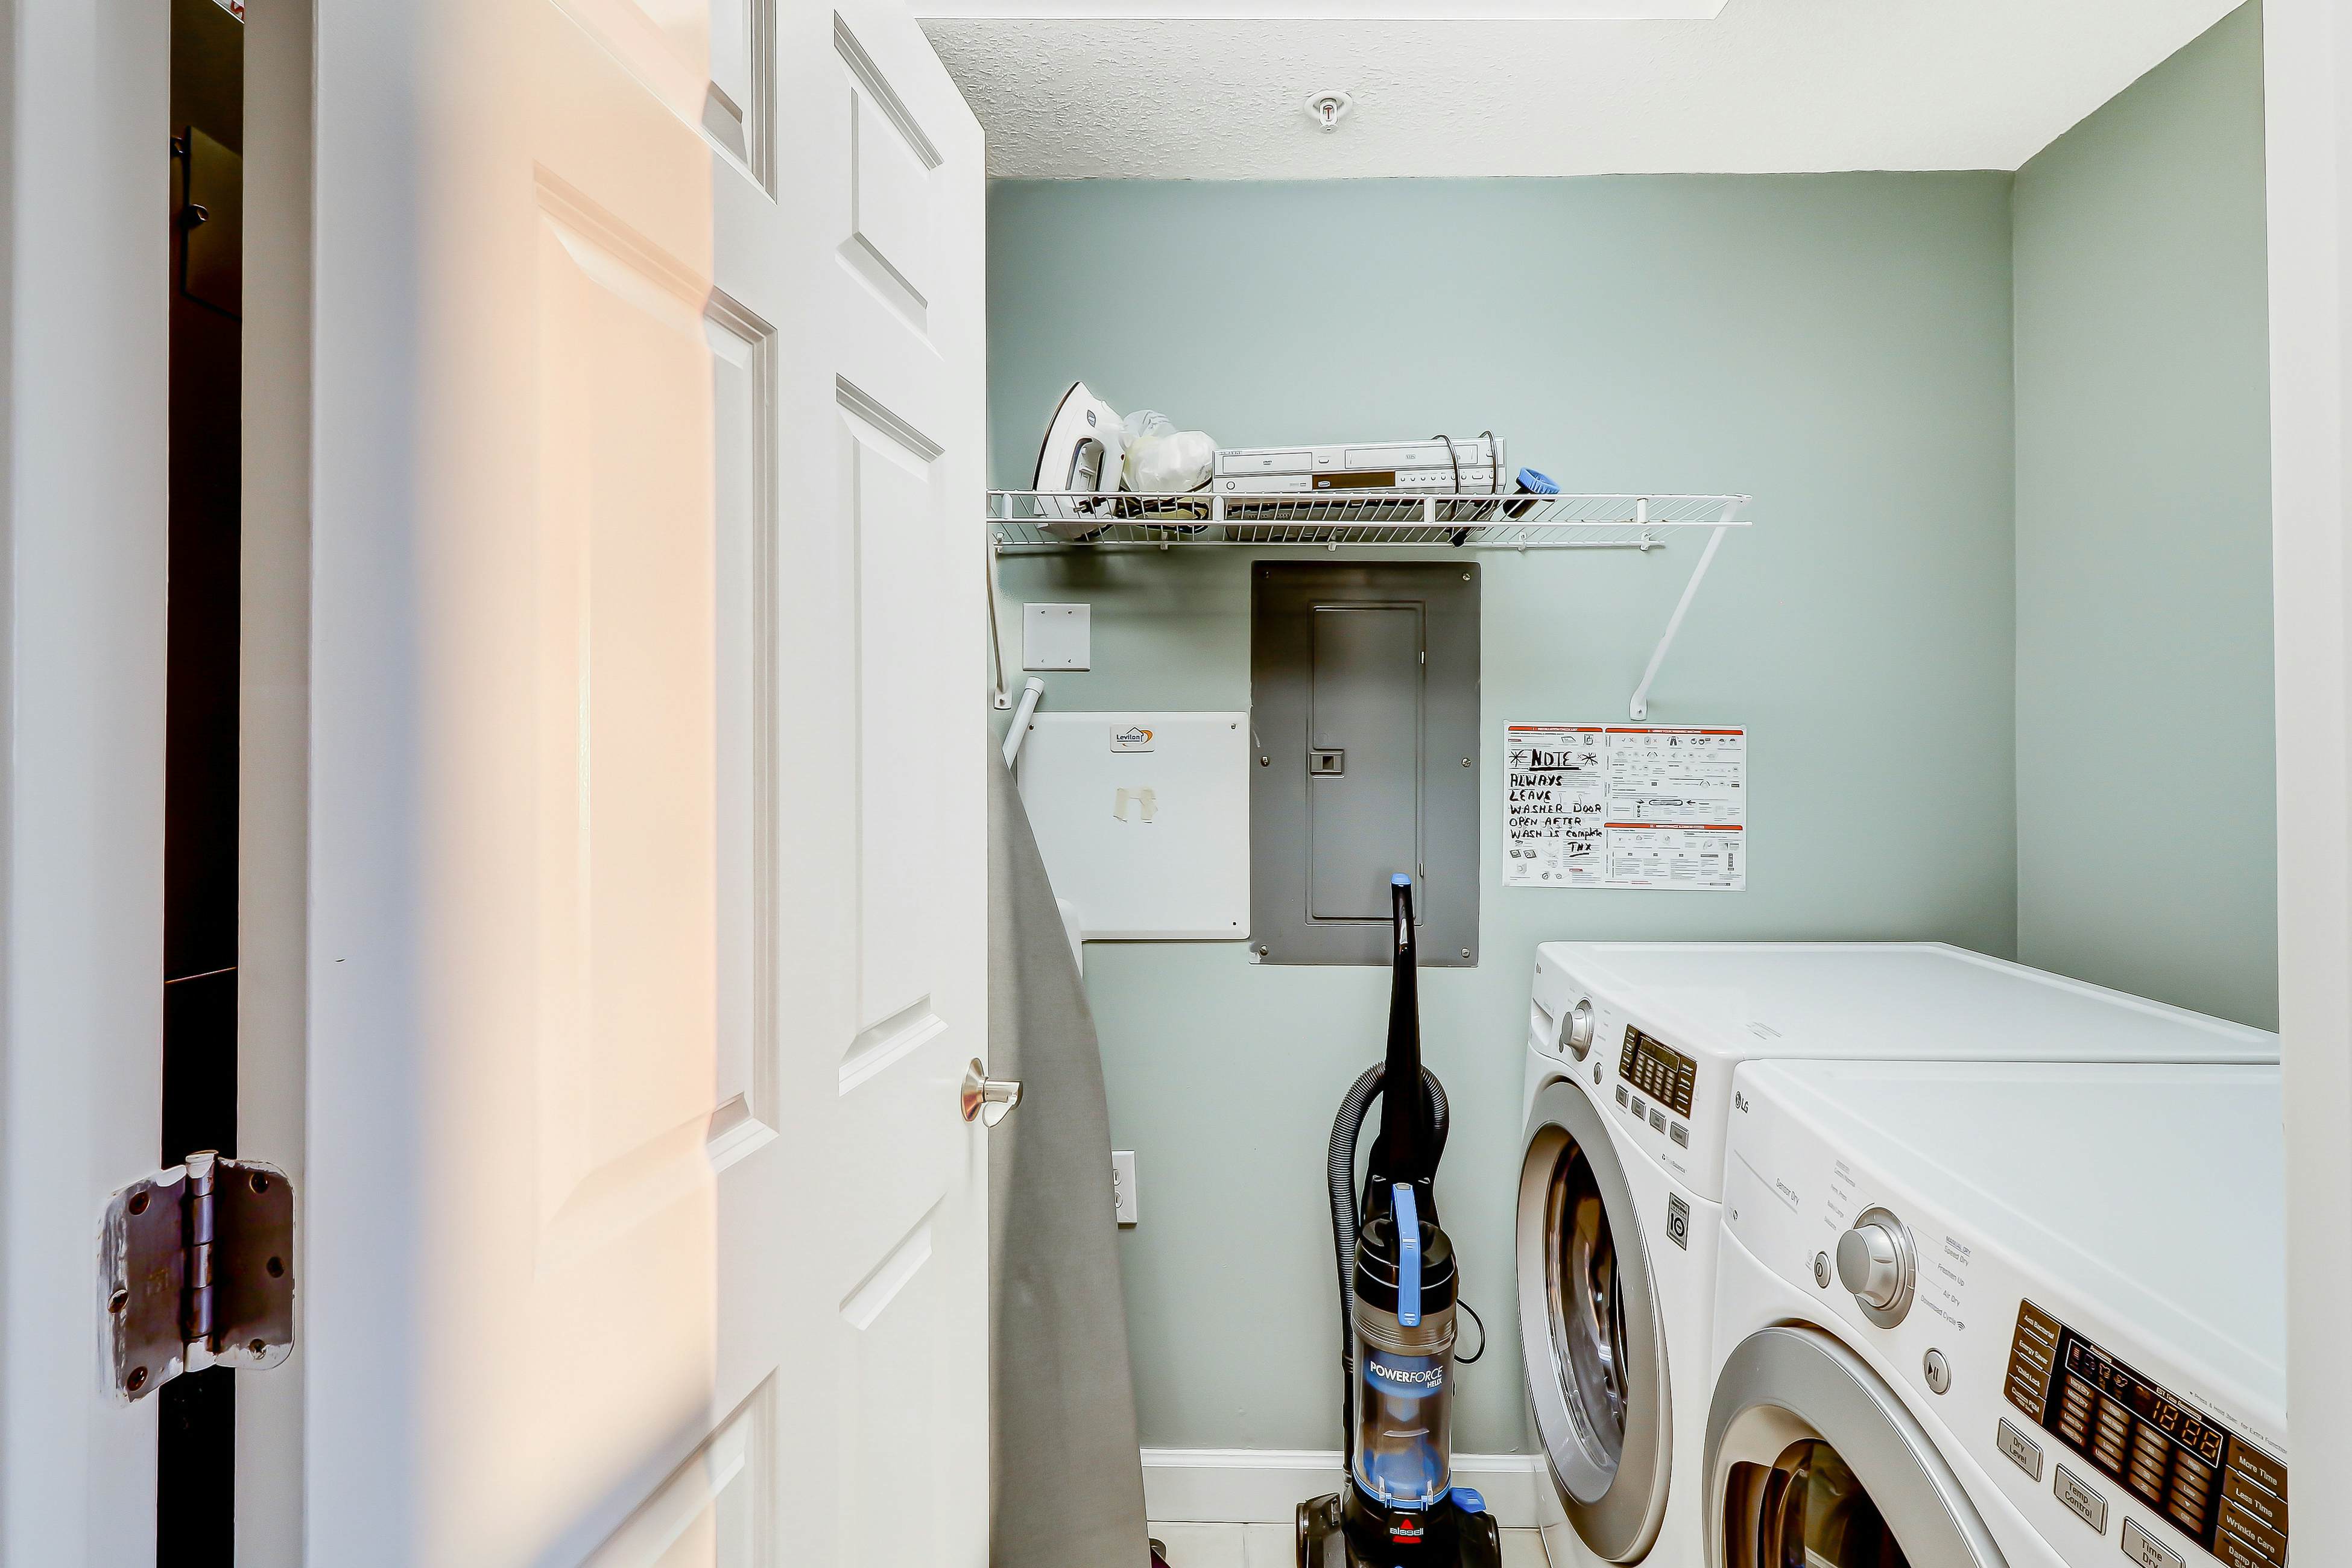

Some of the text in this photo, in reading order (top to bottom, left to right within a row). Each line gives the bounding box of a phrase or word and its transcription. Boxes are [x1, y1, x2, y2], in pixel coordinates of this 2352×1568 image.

[1531, 748, 1573, 767] NOTE
[1510, 773, 1563, 787] ALWAYS
[1509, 789, 1552, 803] LEAVE
[1510, 803, 1602, 814] WASHER DOOR
[1509, 816, 1582, 827] OPEN AFTER
[1510, 829, 1542, 839] WASH
[1791, 1190, 1800, 1206] Dry
[1944, 1245, 1969, 1267] Speed Dry
[1957, 1276, 1965, 1287] Up
[1943, 1289, 1961, 1307] Air Dry
[1943, 1311, 1957, 1326] Cycle
[2024, 1315, 2034, 1326] Anti
[2018, 1339, 2035, 1356] Energy
[1370, 1360, 1444, 1383] POWERFORCE
[2018, 1365, 2030, 1380] Child
[1427, 1377, 1443, 1389] HELIX
[2194, 1393, 2207, 1406] Press
[2249, 1427, 2264, 1441] Extra
[2013, 1437, 2025, 1452] Dry
[2009, 1445, 2028, 1464] Level
[2239, 1455, 2278, 1486] More Time
[2065, 1490, 2093, 1519] Control
[2236, 1487, 2273, 1518] Less Time
[2227, 1514, 2275, 1554] Wrinkle Care
[2141, 1538, 2163, 1563] Time
[2228, 1546, 2250, 1566] Damp
[2142, 1551, 2160, 1568] Dry
